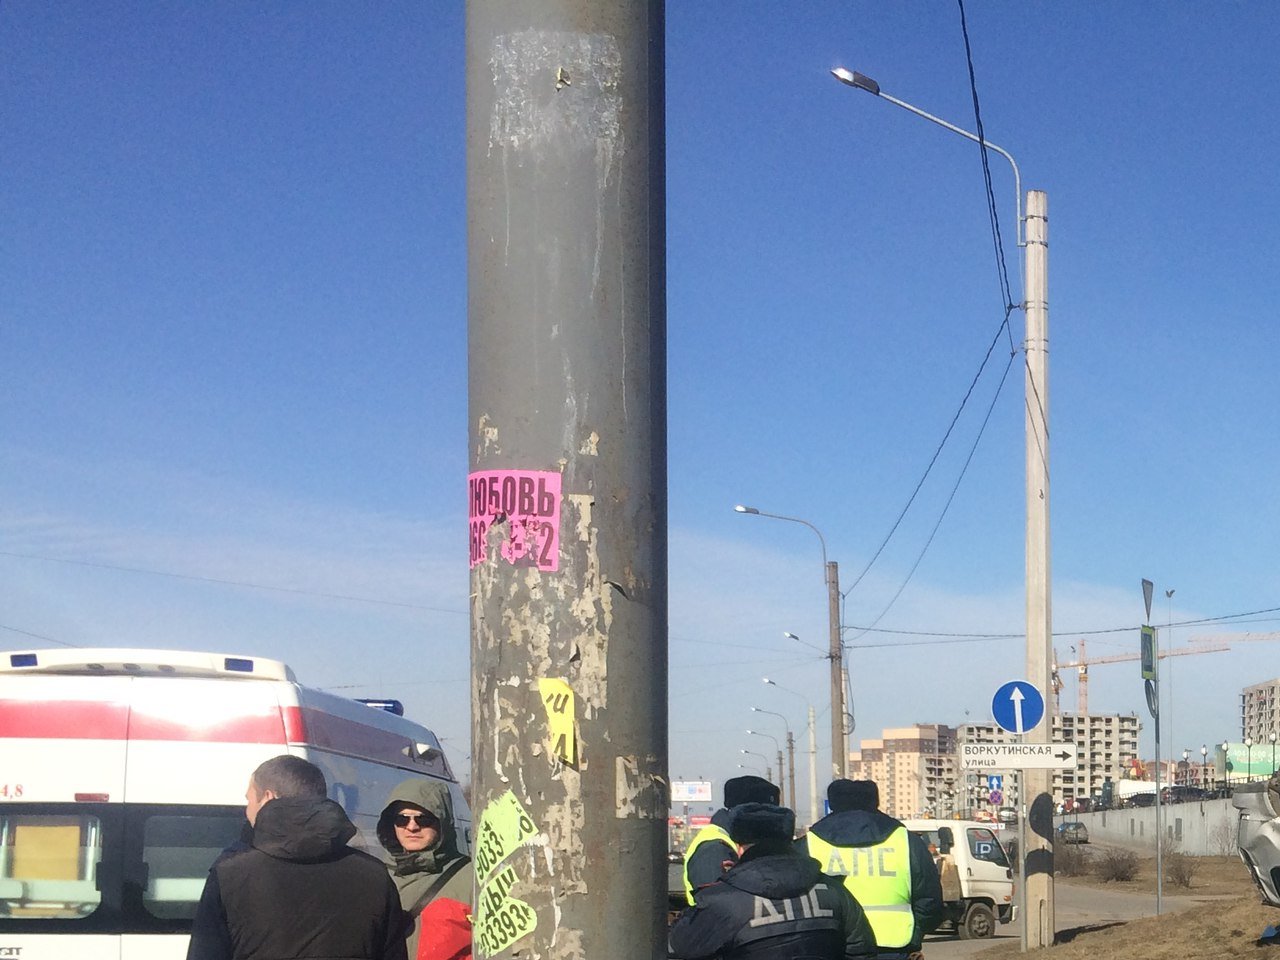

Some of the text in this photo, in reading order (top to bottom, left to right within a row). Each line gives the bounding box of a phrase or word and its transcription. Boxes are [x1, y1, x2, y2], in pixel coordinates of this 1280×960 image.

[964, 746, 1052, 755] ВОРКУТИНСКАЯ
[965, 759, 996, 767] улица
[827, 848, 897, 877] ДПС
[750, 883, 833, 928] ДПС
